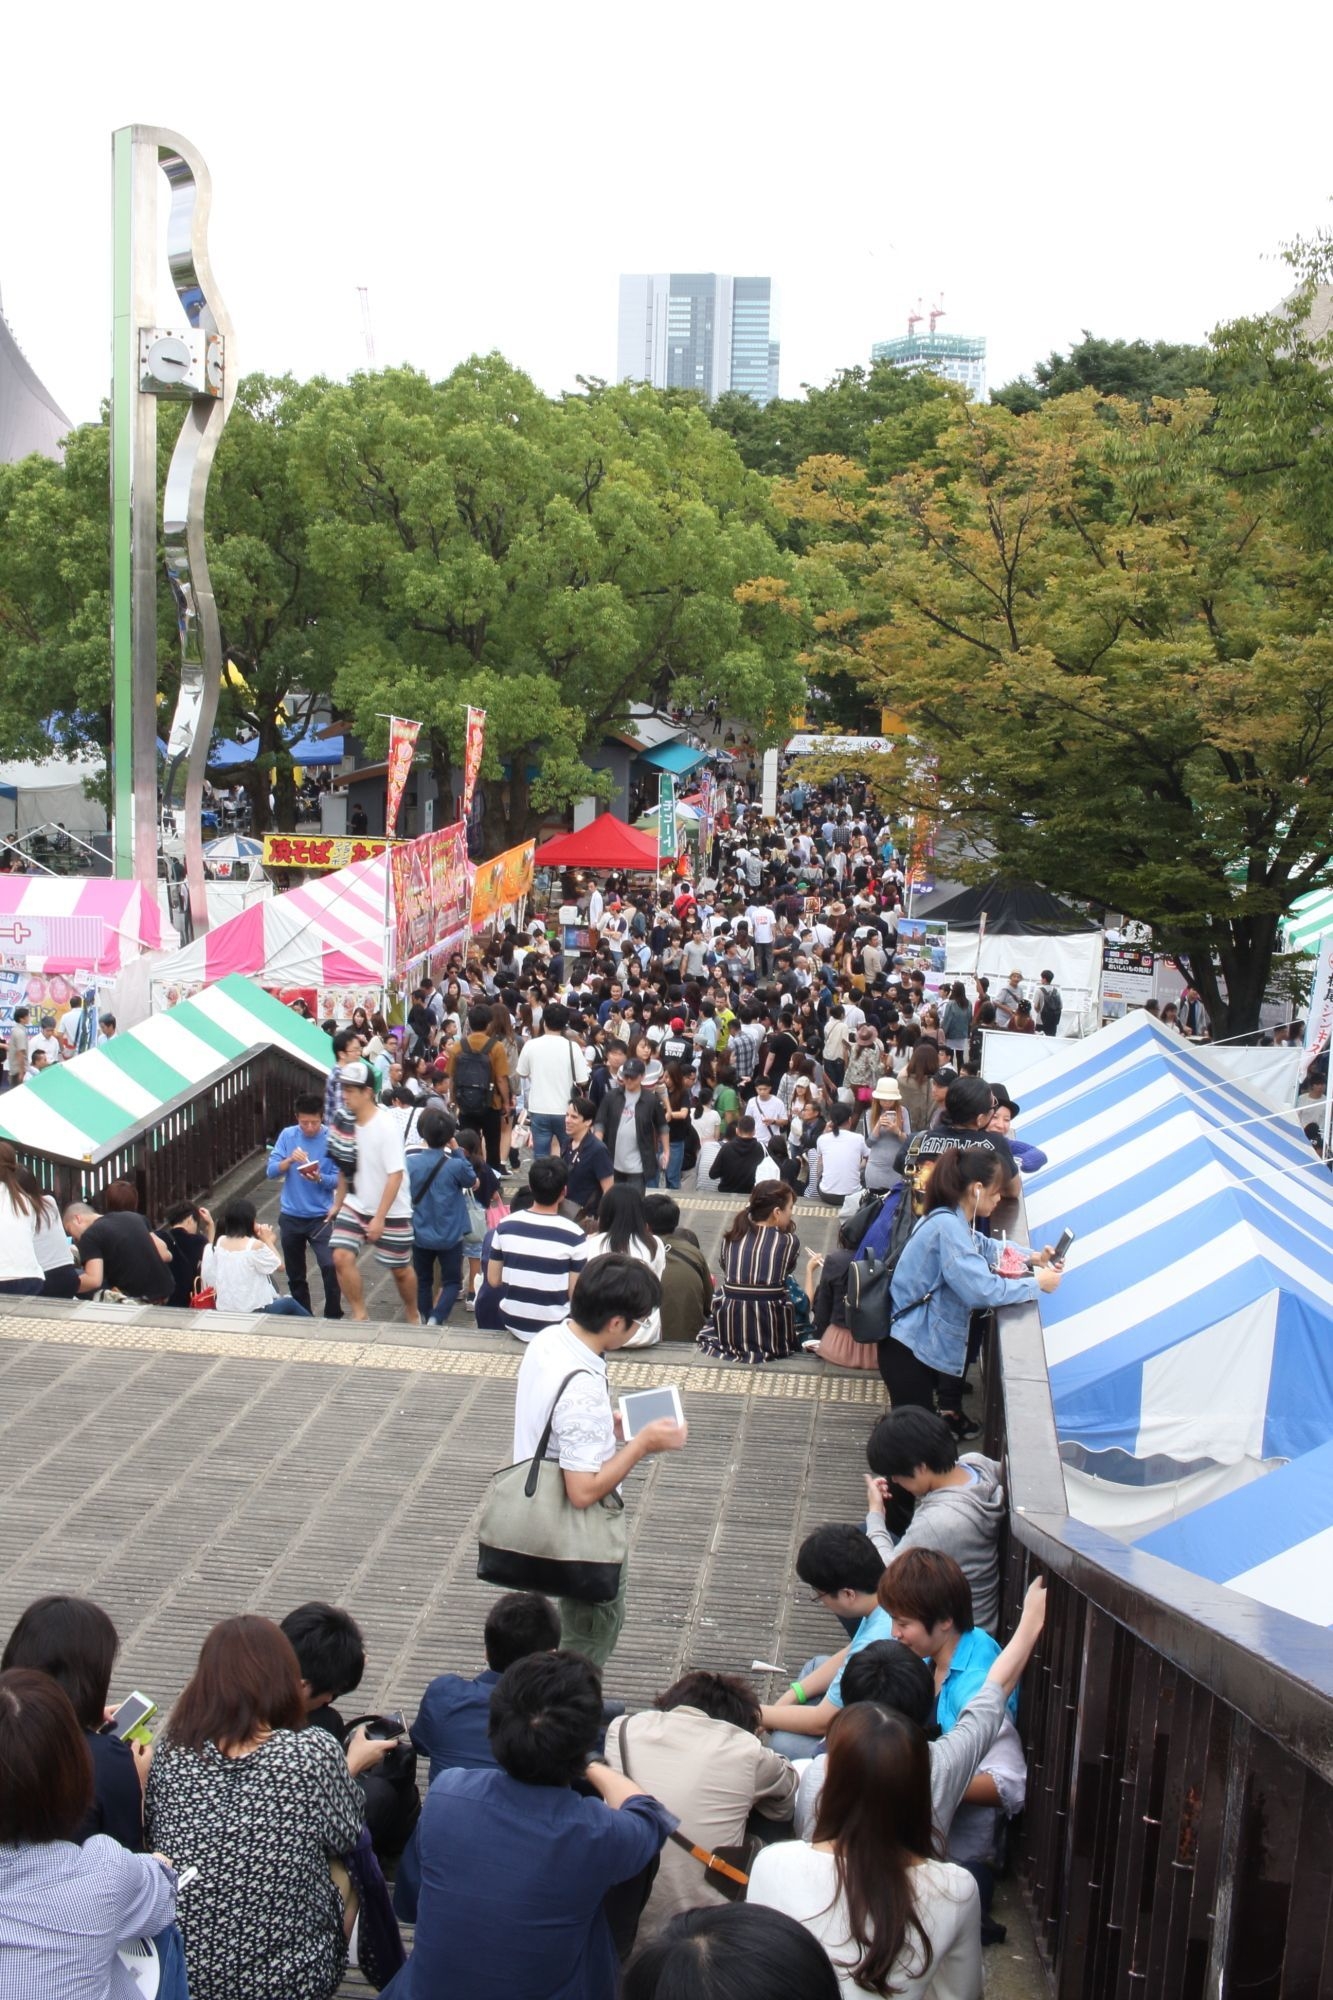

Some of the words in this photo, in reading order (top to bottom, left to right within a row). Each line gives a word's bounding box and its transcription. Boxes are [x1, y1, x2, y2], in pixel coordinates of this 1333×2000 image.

[269, 838, 334, 864] 焼そば
[665, 1050, 683, 1058] STAFF
